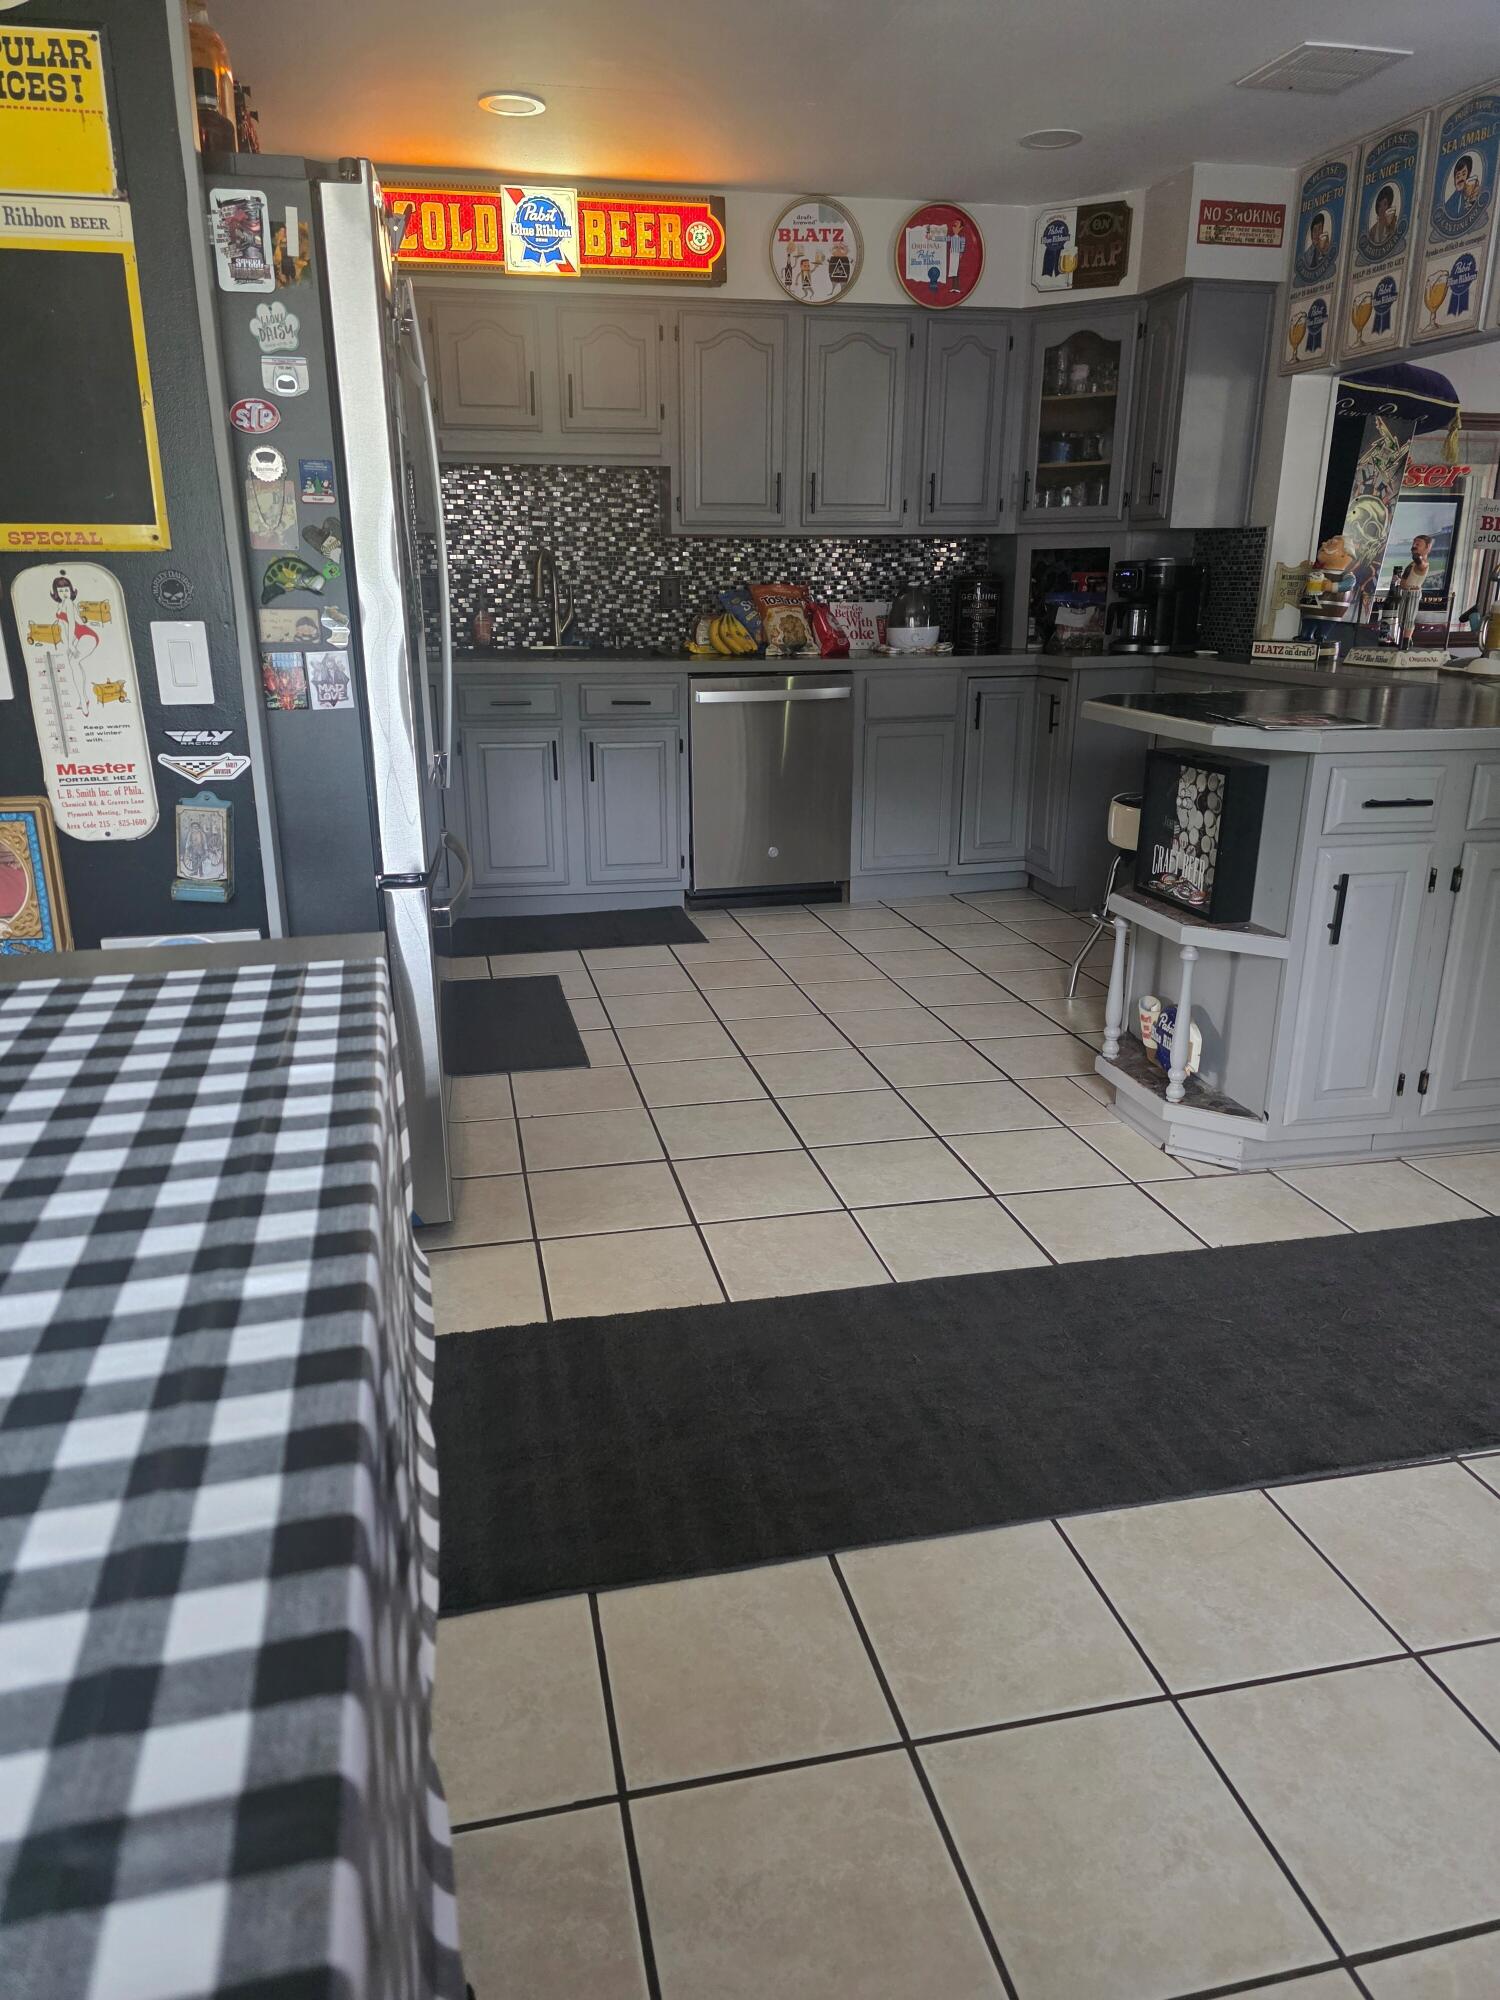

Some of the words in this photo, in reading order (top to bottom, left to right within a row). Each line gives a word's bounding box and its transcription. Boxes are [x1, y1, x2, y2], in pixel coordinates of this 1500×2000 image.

[0, 36, 92, 70] ULAR
[1377, 135, 1408, 154] PLEASE
[1443, 139, 1457, 155] SEA
[1365, 172, 1377, 185] BE
[1380, 162, 1400, 179] NICE
[1404, 156, 1415, 169] TO
[2, 205, 66, 228] Ribbon
[70, 216, 111, 230] BEER
[523, 203, 558, 222] Pabst
[1203, 206, 1222, 221] NO
[1225, 208, 1281, 224] SMOKING
[511, 223, 535, 237] Blue
[535, 223, 572, 237] Ribbon
[582, 210, 684, 260] BEER
[778, 228, 844, 242] BLATZ
[1080, 241, 1122, 268] TAP
[1455, 261, 1471, 275] Pabst
[258, 324, 294, 342] DAISY
[235, 402, 274, 431] STP
[1402, 464, 1472, 488] ser
[8, 531, 104, 545] SPECIAL
[835, 609, 863, 618] Better
[846, 616, 873, 627] With
[1254, 645, 1284, 655] BLATZ
[1295, 648, 1312, 657] draft
[318, 683, 344, 693] MAD
[320, 692, 346, 700] LOVE
[180, 730, 233, 742] FLY
[56, 763, 136, 775] Master
[67, 789, 74, 798] B.
[76, 788, 96, 798] Smith
[114, 786, 121, 796] of
[1152, 844, 1180, 875] CRAFT
[1182, 854, 1206, 892] BEER
